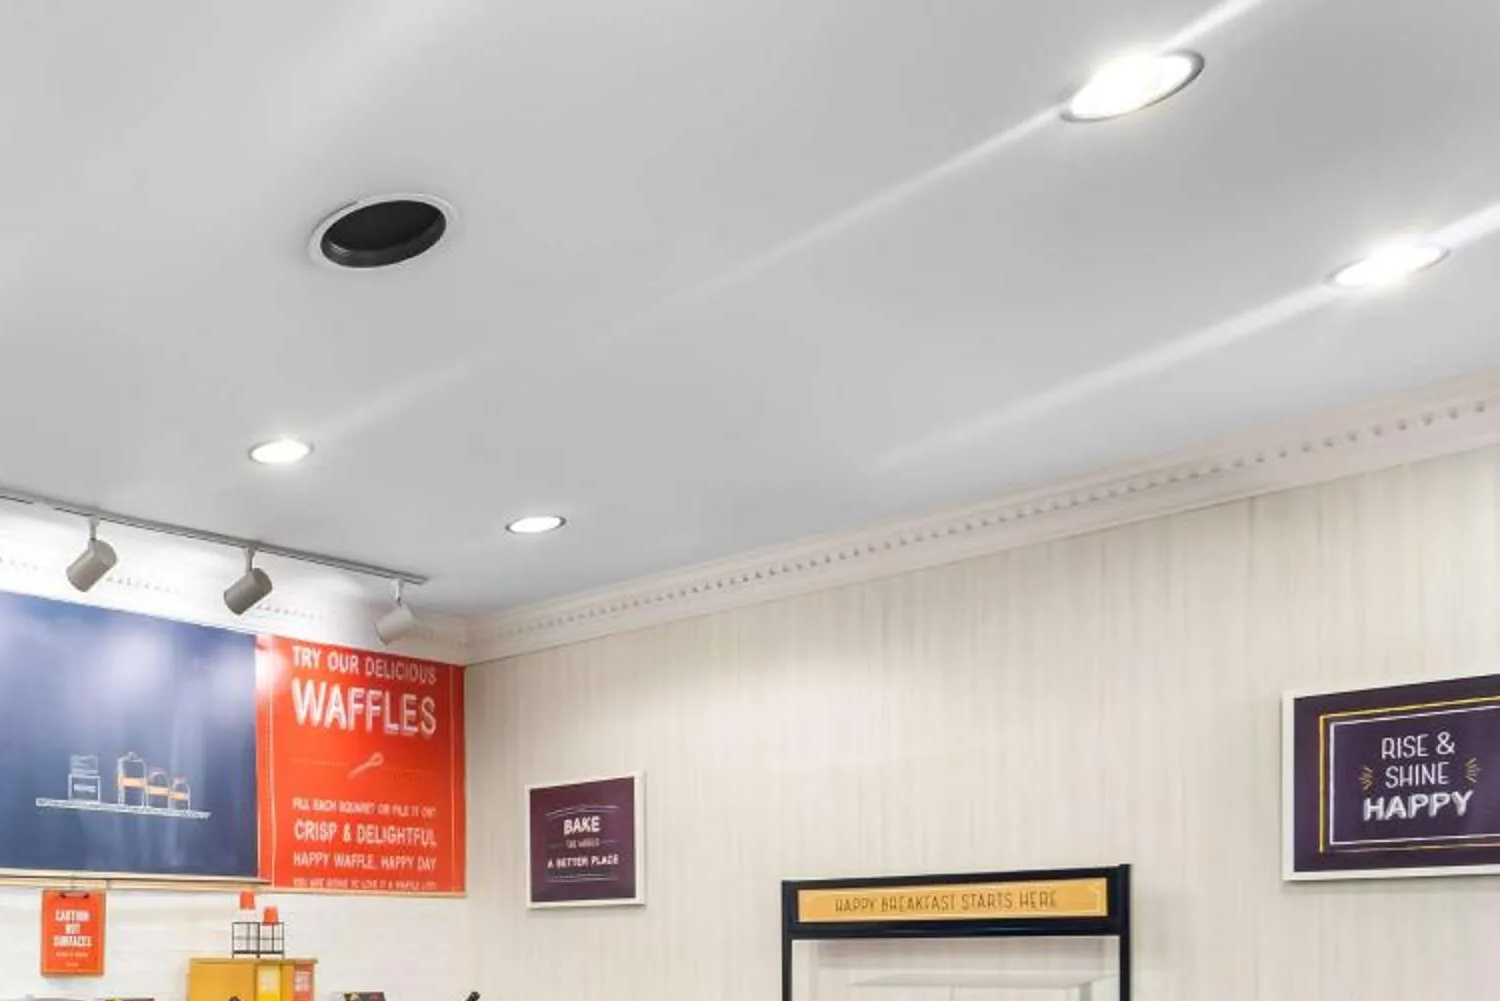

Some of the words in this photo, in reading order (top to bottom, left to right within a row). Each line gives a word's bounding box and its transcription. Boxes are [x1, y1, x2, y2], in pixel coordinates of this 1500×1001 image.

[292, 646, 322, 668] TRY
[327, 650, 360, 675] OUR
[365, 656, 437, 685] DELICIOUS
[292, 676, 437, 737] WAFFLES
[1381, 733, 1429, 760] RISE
[1435, 731, 1456, 755] &
[1385, 762, 1449, 789] SHINE
[1363, 790, 1474, 821] HAPPY
[294, 820, 337, 843] CRISP
[343, 822, 352, 843] &
[357, 824, 437, 847] DELIGHTFUL
[564, 815, 600, 836] BAKE
[293, 852, 330, 868] HAPPY
[381, 855, 414, 871] HAPPY
[417, 856, 437, 872] DAY
[556, 857, 588, 868] BETTER
[591, 854, 618, 865] PLACE
[835, 897, 875, 913] HAPPY
[881, 893, 956, 912] BREAKFAST
[961, 891, 1013, 909] STARTS
[1019, 889, 1057, 908] HERE
